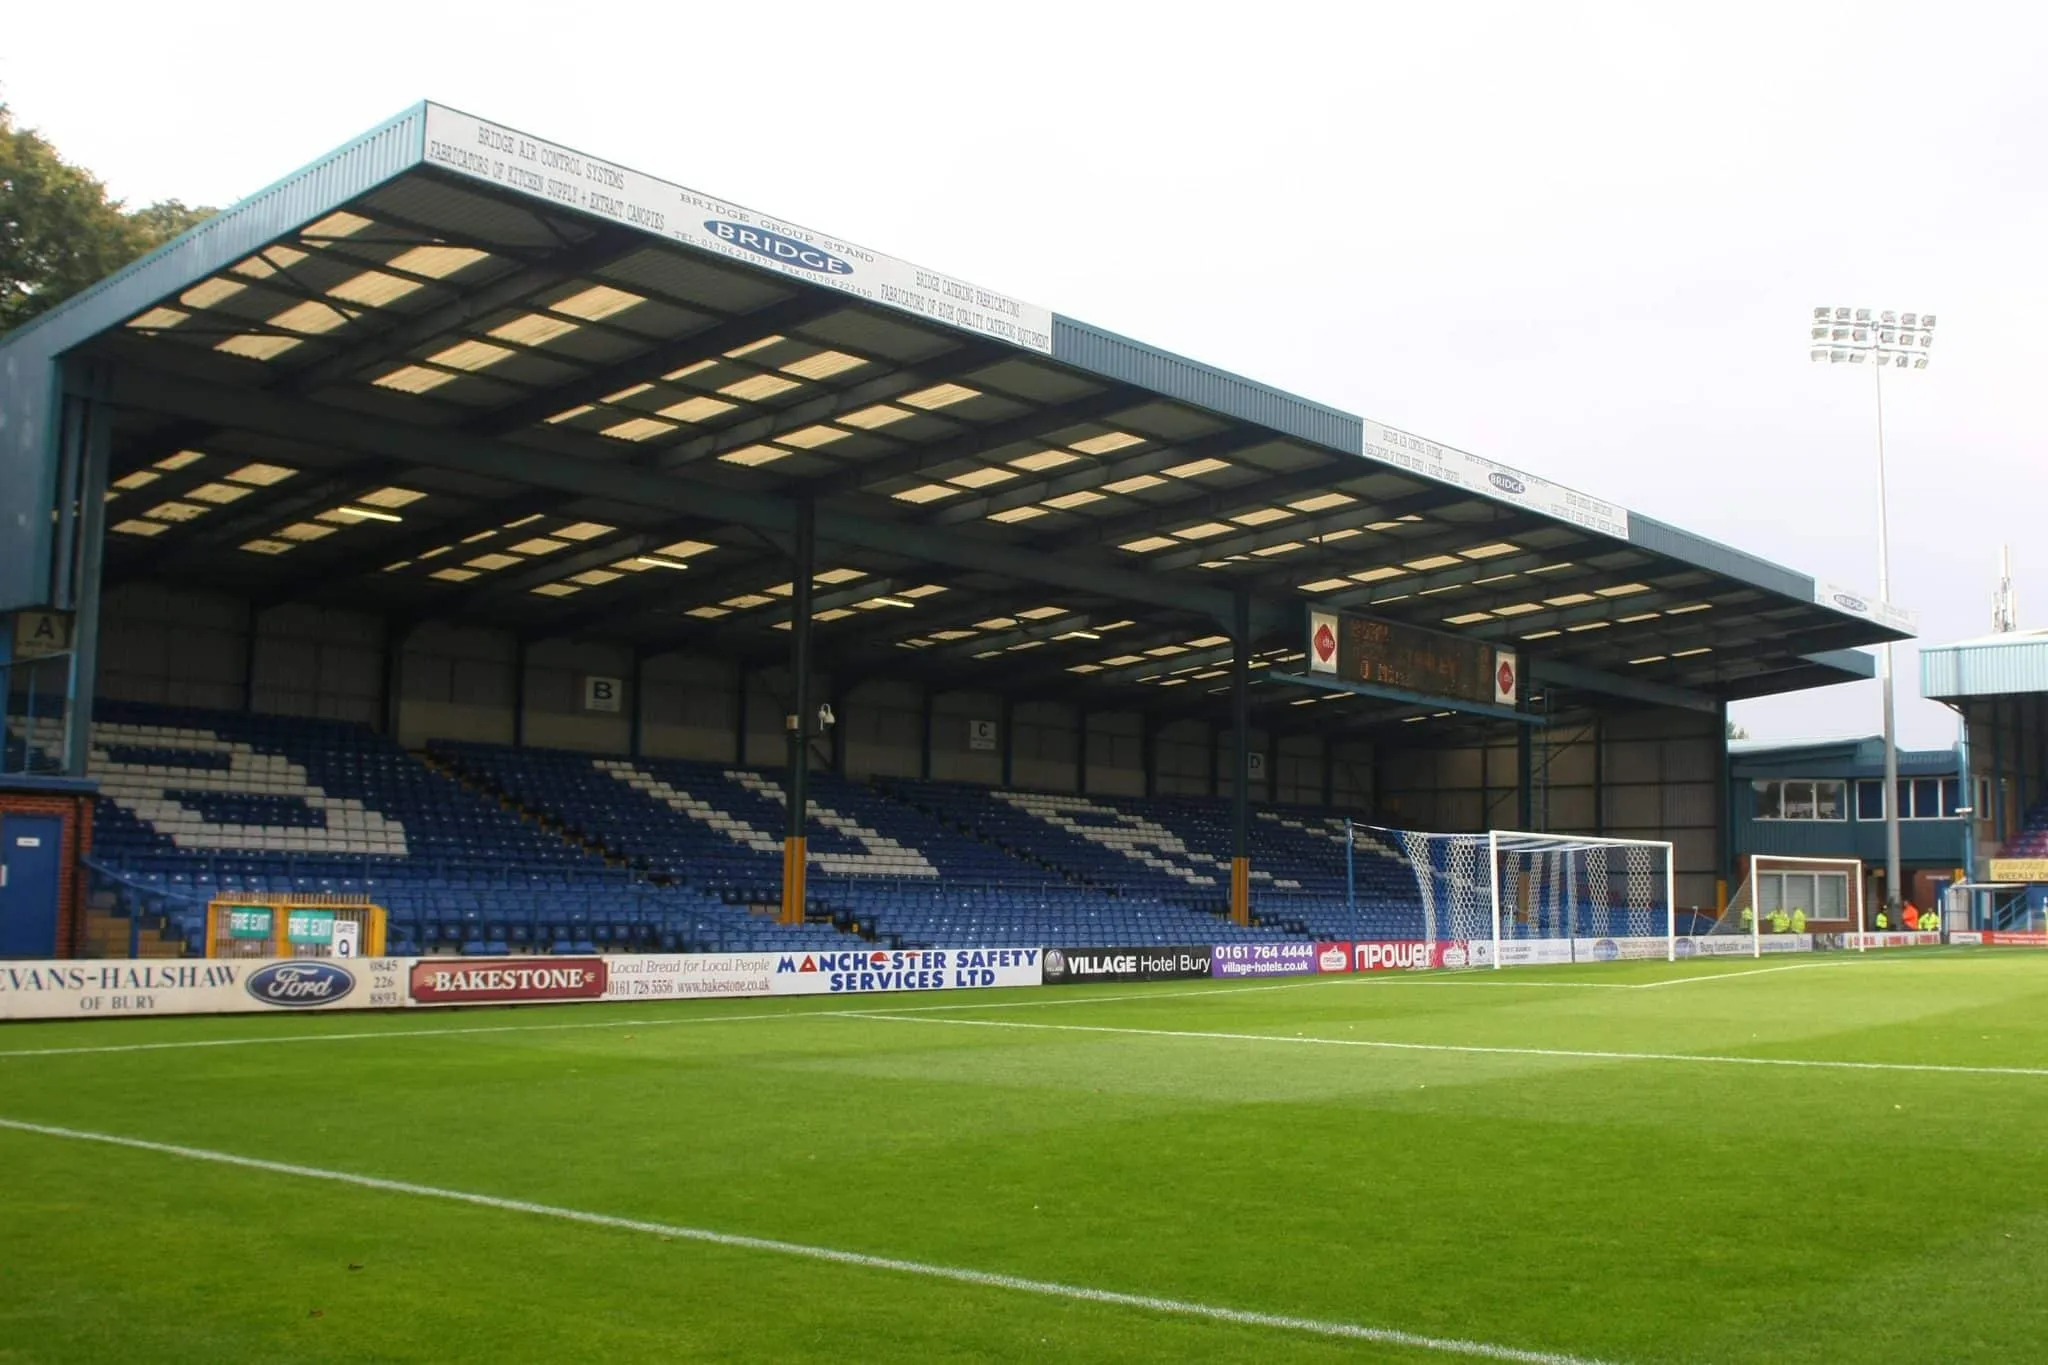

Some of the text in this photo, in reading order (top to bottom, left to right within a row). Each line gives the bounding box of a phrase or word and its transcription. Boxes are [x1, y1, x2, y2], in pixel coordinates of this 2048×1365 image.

[478, 126, 625, 190] BRIDGE AIR CONTROL SYSTEMS
[430, 140, 489, 175] FABRICATORS
[493, 160, 505, 179] OF
[508, 165, 544, 192] KITCHEN
[547, 178, 578, 203] SUPPLY
[590, 192, 624, 218] EXTRACT
[627, 204, 664, 231] CANOPIES
[680, 193, 875, 263] BRIDGE GROUP STAND
[716, 222, 844, 274] BRIDGE
[916, 271, 940, 292] BRIDGE
[943, 279, 974, 303] CATERING
[1490, 475, 1525, 493] BRIDGE
[34, 616, 55, 640] A
[593, 681, 613, 700] B
[978, 723, 989, 738] C
[1250, 755, 1261, 769] D
[230, 912, 270, 931] FIRE EXIT
[288, 917, 332, 936] FIRE EXIT
[336, 922, 356, 934] GATE
[338, 939, 350, 958] 9
[1215, 945, 1313, 959] 0161 764 4444
[610, 958, 769, 975] Local Bread for Local People
[777, 950, 1037, 973] MANCHESTER SAFETY
[1068, 955, 1137, 974] VILLAGE
[1141, 955, 1176, 972] Hotel
[1180, 954, 1210, 973] Bury
[1222, 960, 1308, 975] village-hotels.co.uk
[267, 967, 334, 997] Ford
[434, 968, 584, 992] BAKESTONE
[608, 981, 630, 995] 0161
[678, 978, 770, 993] www.bakestone.co.uk
[830, 970, 995, 991] SERVICES LTD
[80, 995, 158, 1010] OF BURY
